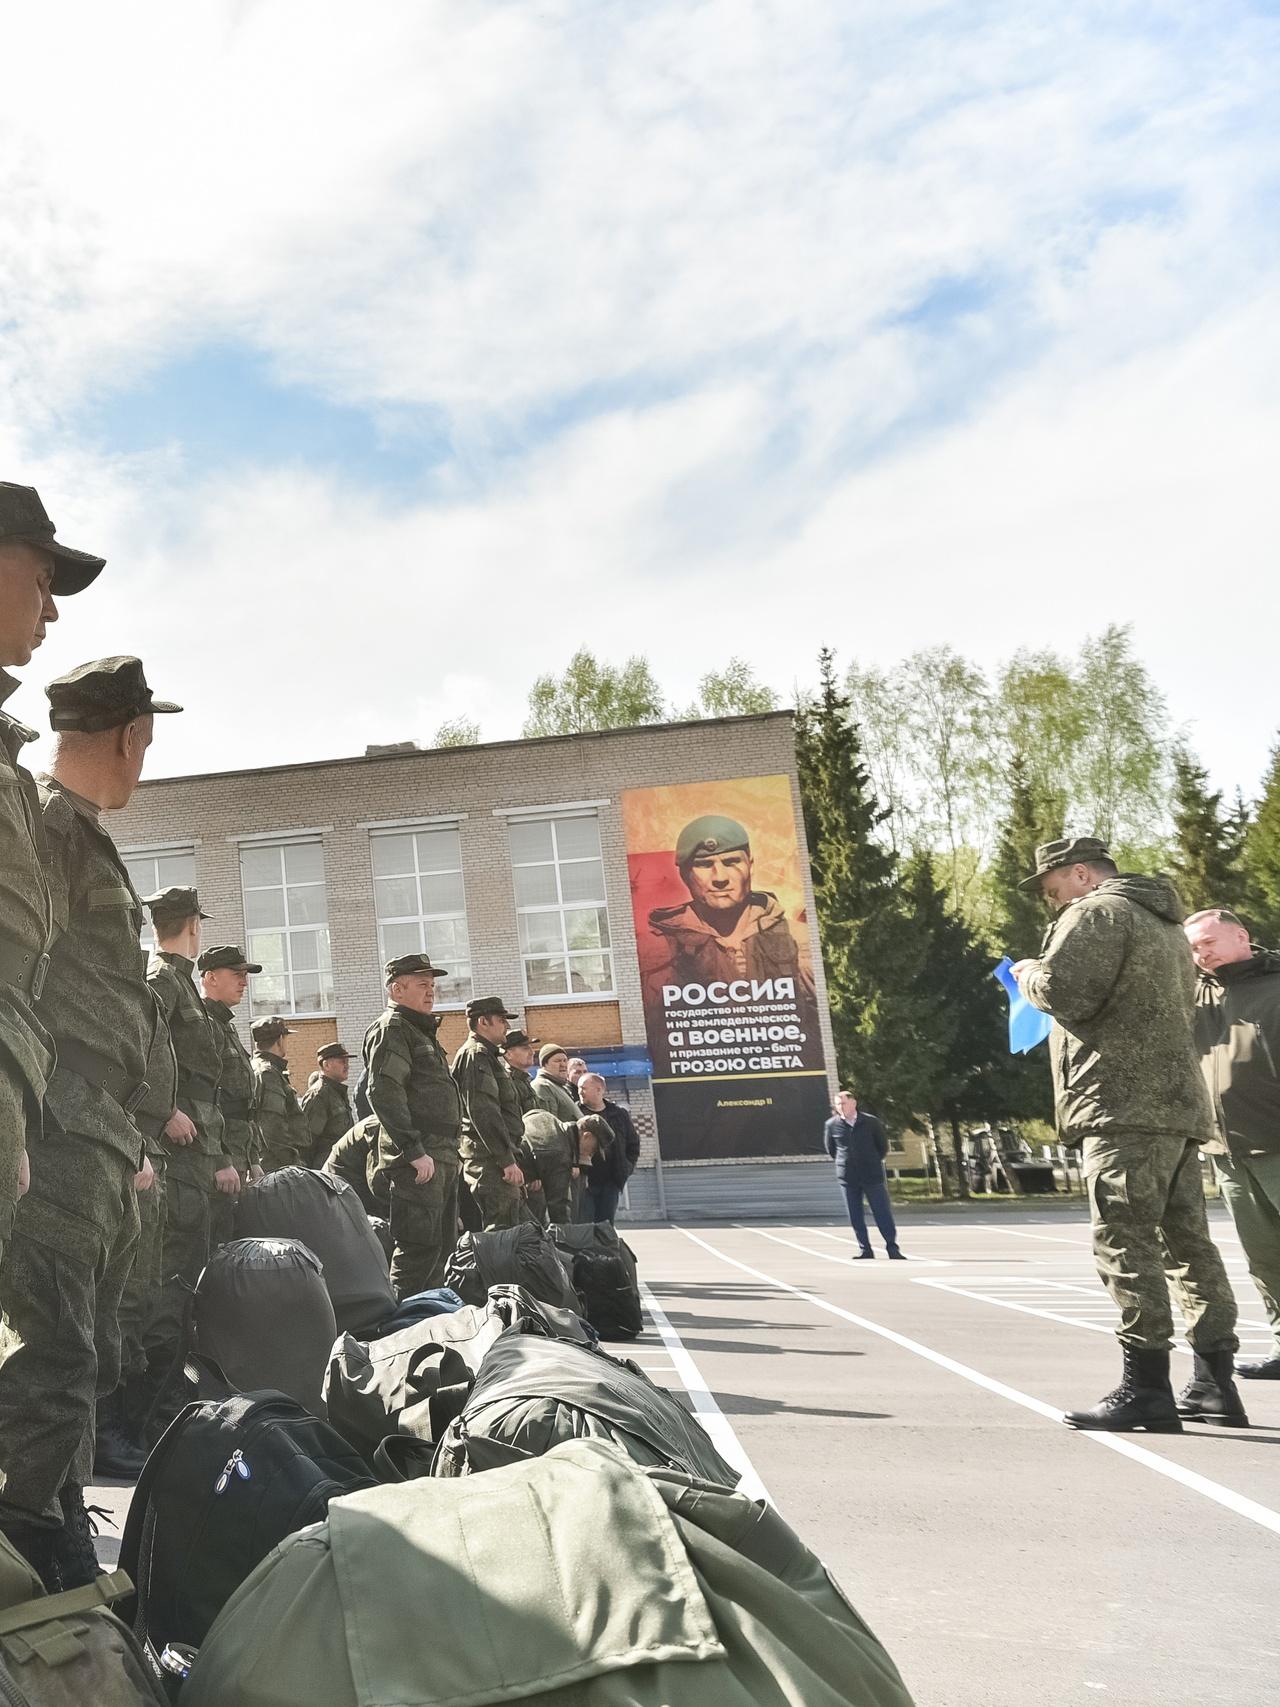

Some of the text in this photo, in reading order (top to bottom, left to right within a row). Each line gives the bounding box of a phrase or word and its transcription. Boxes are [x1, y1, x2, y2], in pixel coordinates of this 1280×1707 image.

[662, 977, 795, 1006] РОССИЯ
[665, 1003, 797, 1018] государство не торговое
[666, 1014, 801, 1029] и не земледельческое,
[668, 1024, 807, 1046] а военное,
[669, 1050, 678, 1058] и
[679, 1046, 741, 1059] призвание
[742, 1046, 763, 1055] его
[771, 1042, 802, 1053] быть
[670, 1055, 804, 1074] ГРОЗОЮ СВЕТА
[717, 1099, 766, 1107] Александр
